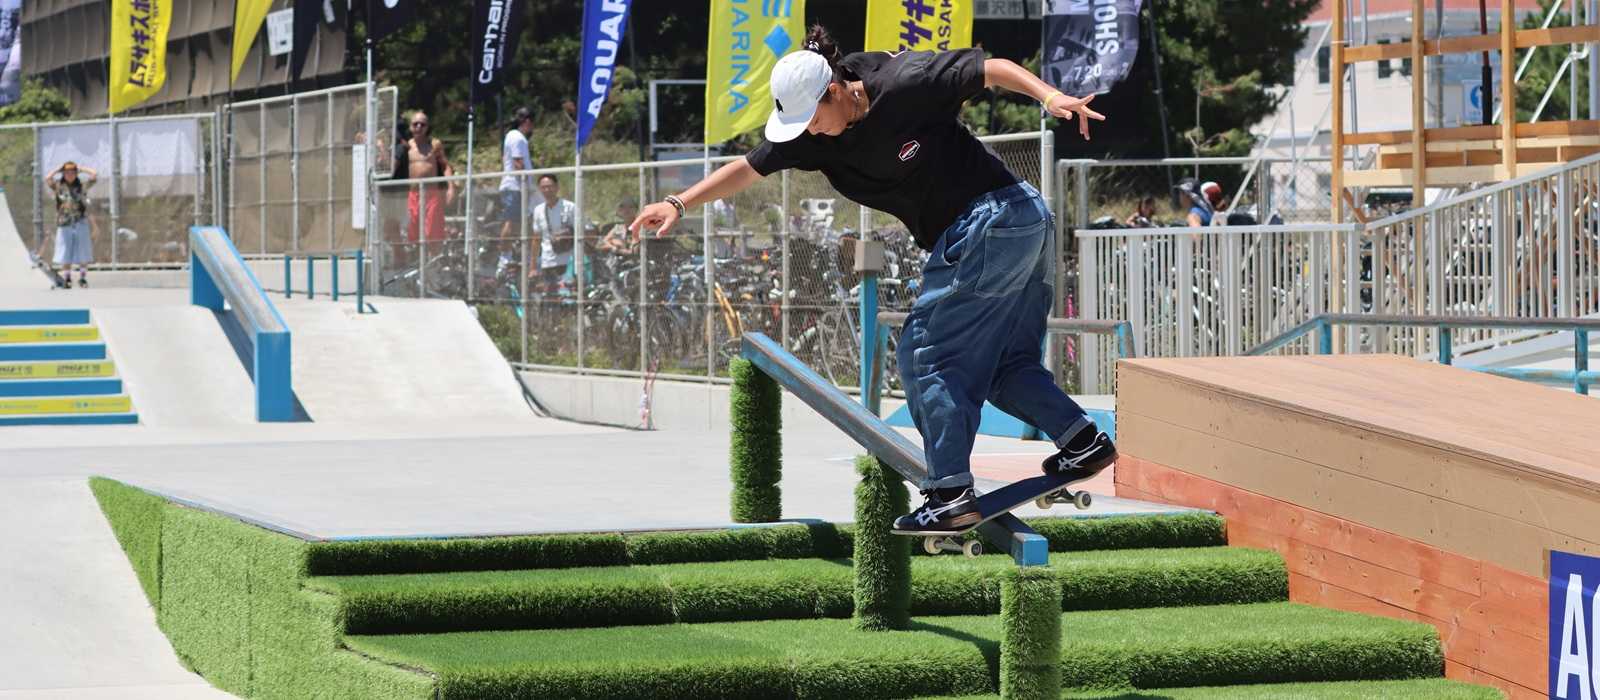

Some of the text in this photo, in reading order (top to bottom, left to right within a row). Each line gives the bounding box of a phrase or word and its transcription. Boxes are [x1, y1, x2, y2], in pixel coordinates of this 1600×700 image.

[898, 0, 935, 52] サキ
[1094, 0, 1120, 56] SHO
[1556, 573, 1600, 700] A
